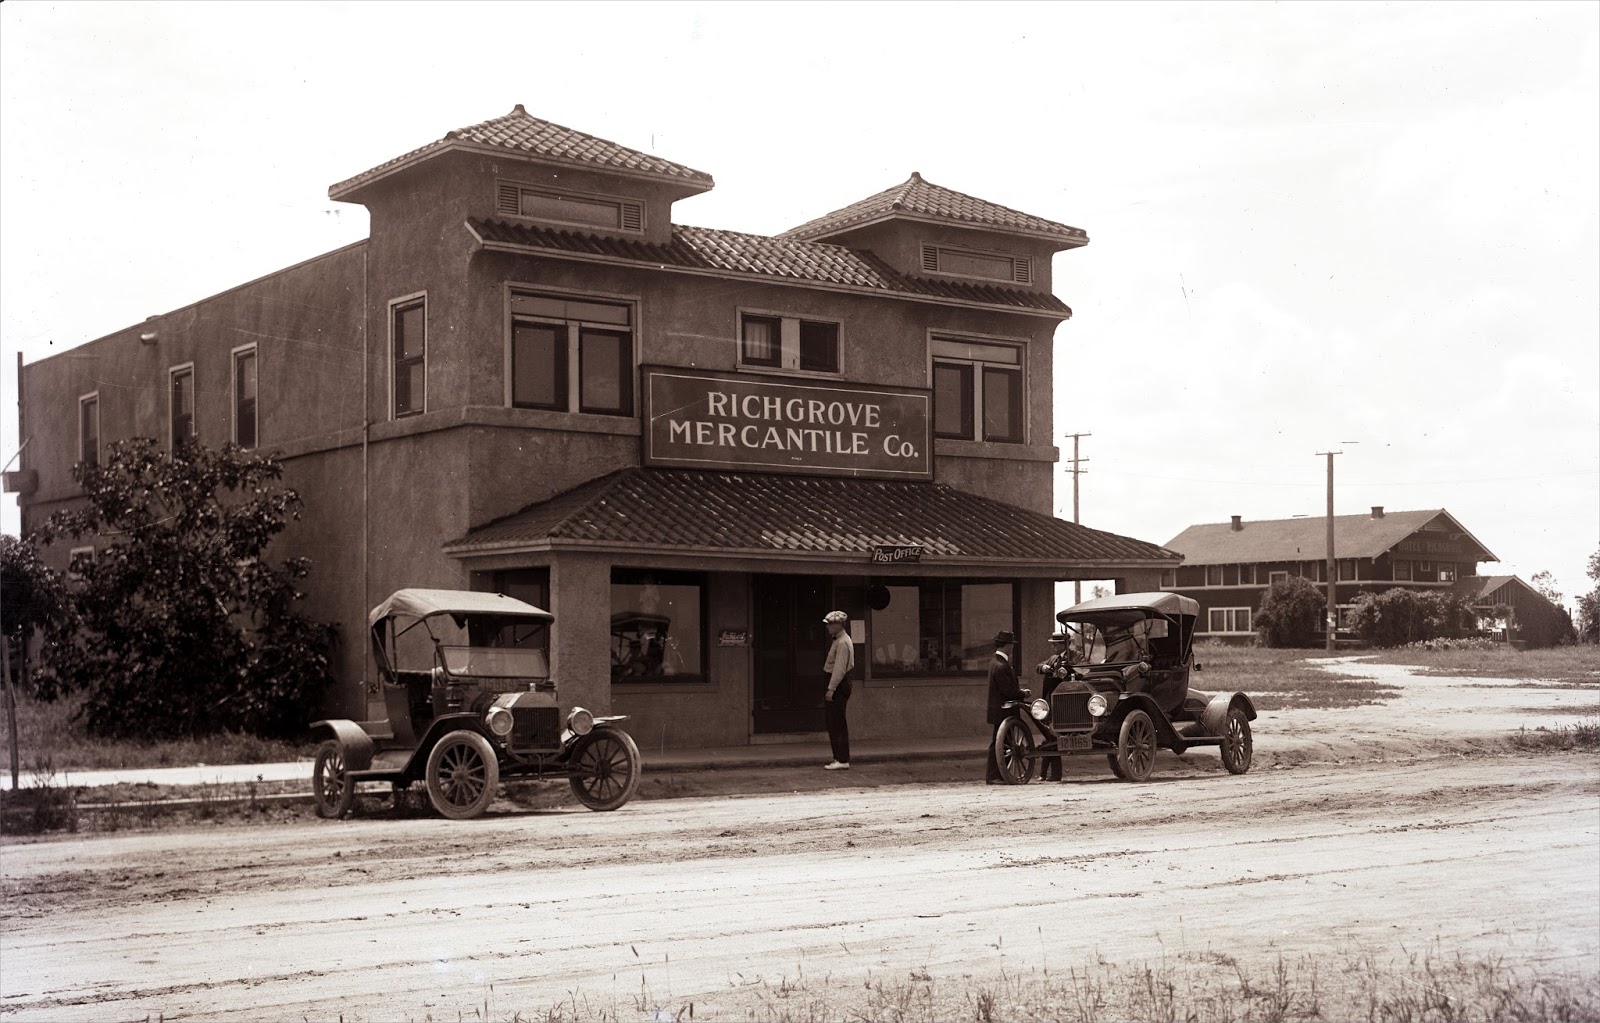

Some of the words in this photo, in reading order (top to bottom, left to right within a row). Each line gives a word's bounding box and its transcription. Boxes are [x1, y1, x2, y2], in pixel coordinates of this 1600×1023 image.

[707, 391, 881, 428] RICHGROVE
[668, 419, 870, 455] MERCANTILE
[874, 548, 894, 562] POST
[893, 546, 922, 560] OFFICE
[1399, 541, 1421, 552] HOTEL
